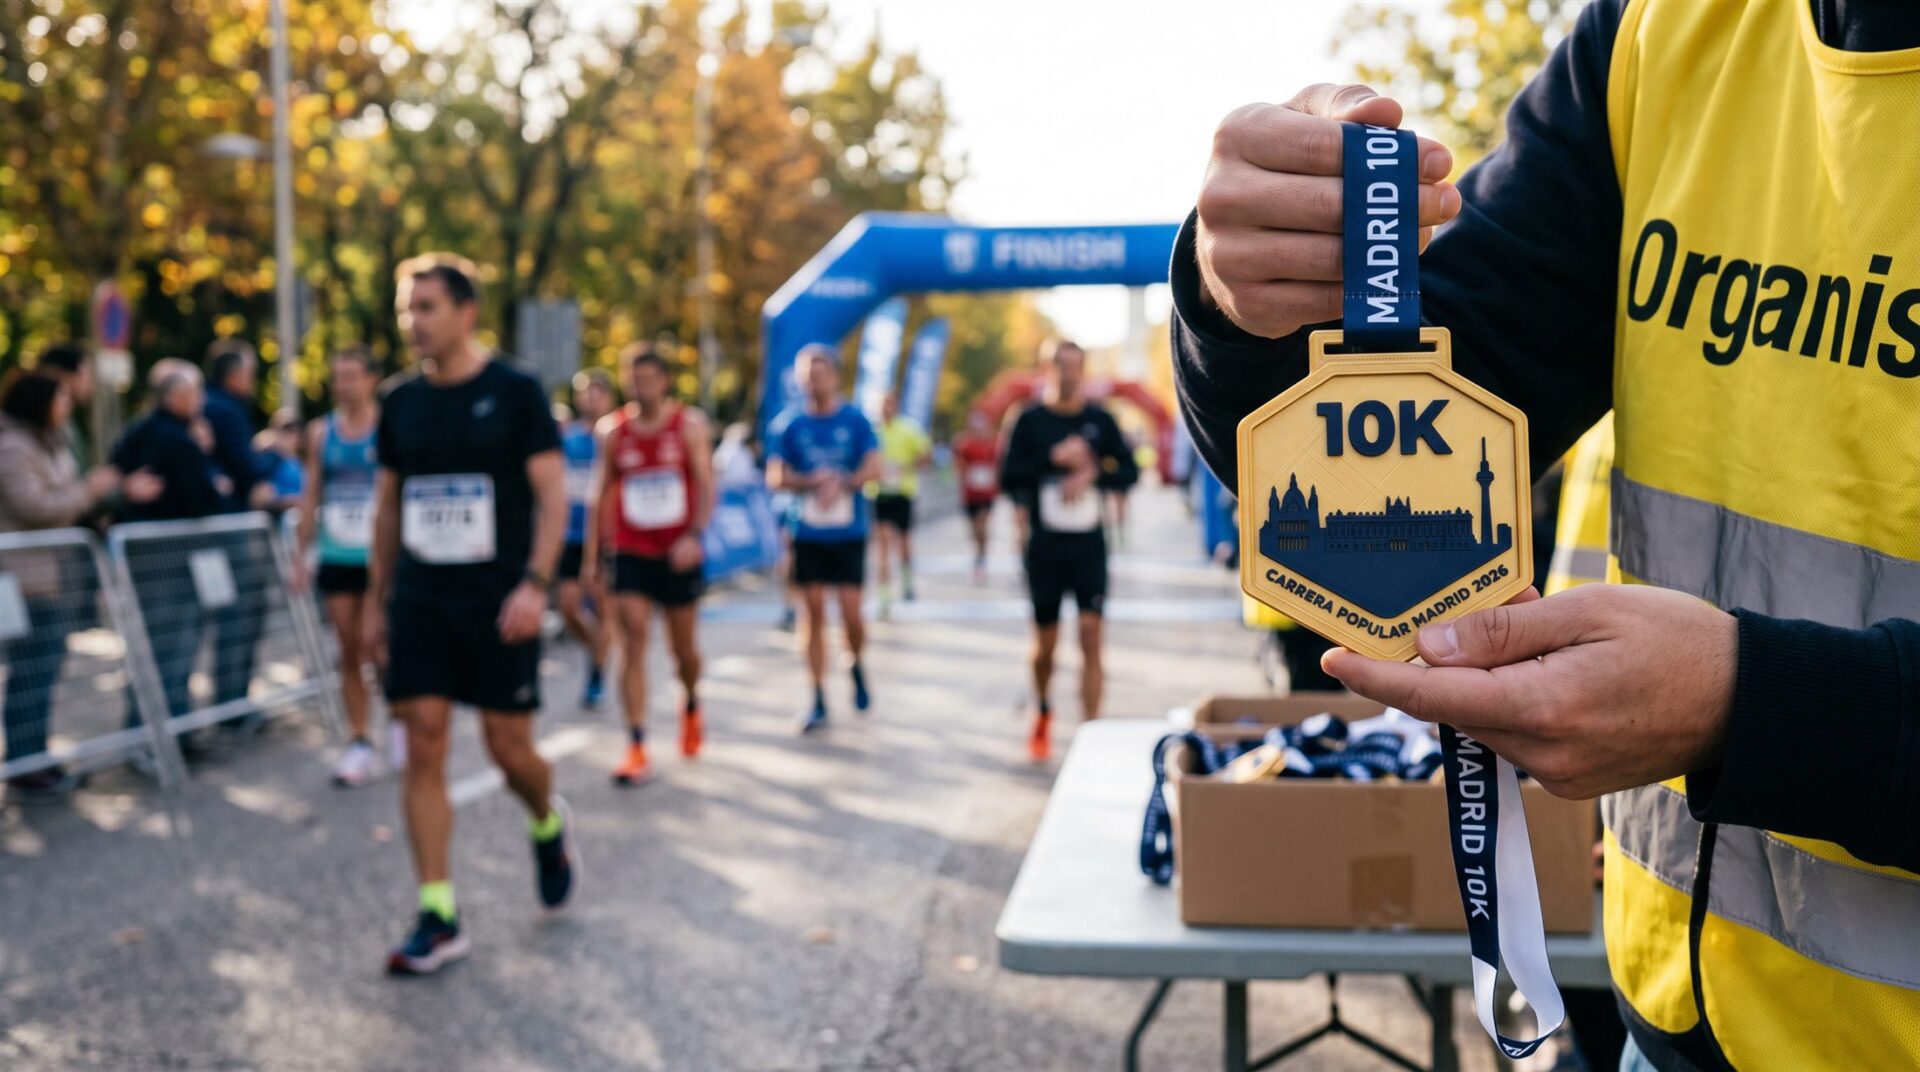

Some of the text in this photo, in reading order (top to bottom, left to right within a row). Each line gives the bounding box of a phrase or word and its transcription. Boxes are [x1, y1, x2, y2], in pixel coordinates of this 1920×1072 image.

[992, 232, 1127, 272] FINISH
[1366, 181, 1399, 323] MADRID
[1316, 399, 1453, 457] 10K
[1265, 564, 1509, 639] CARRERA POPULAR MADRID 2026
[1455, 732, 1490, 921] MADRID 10K
